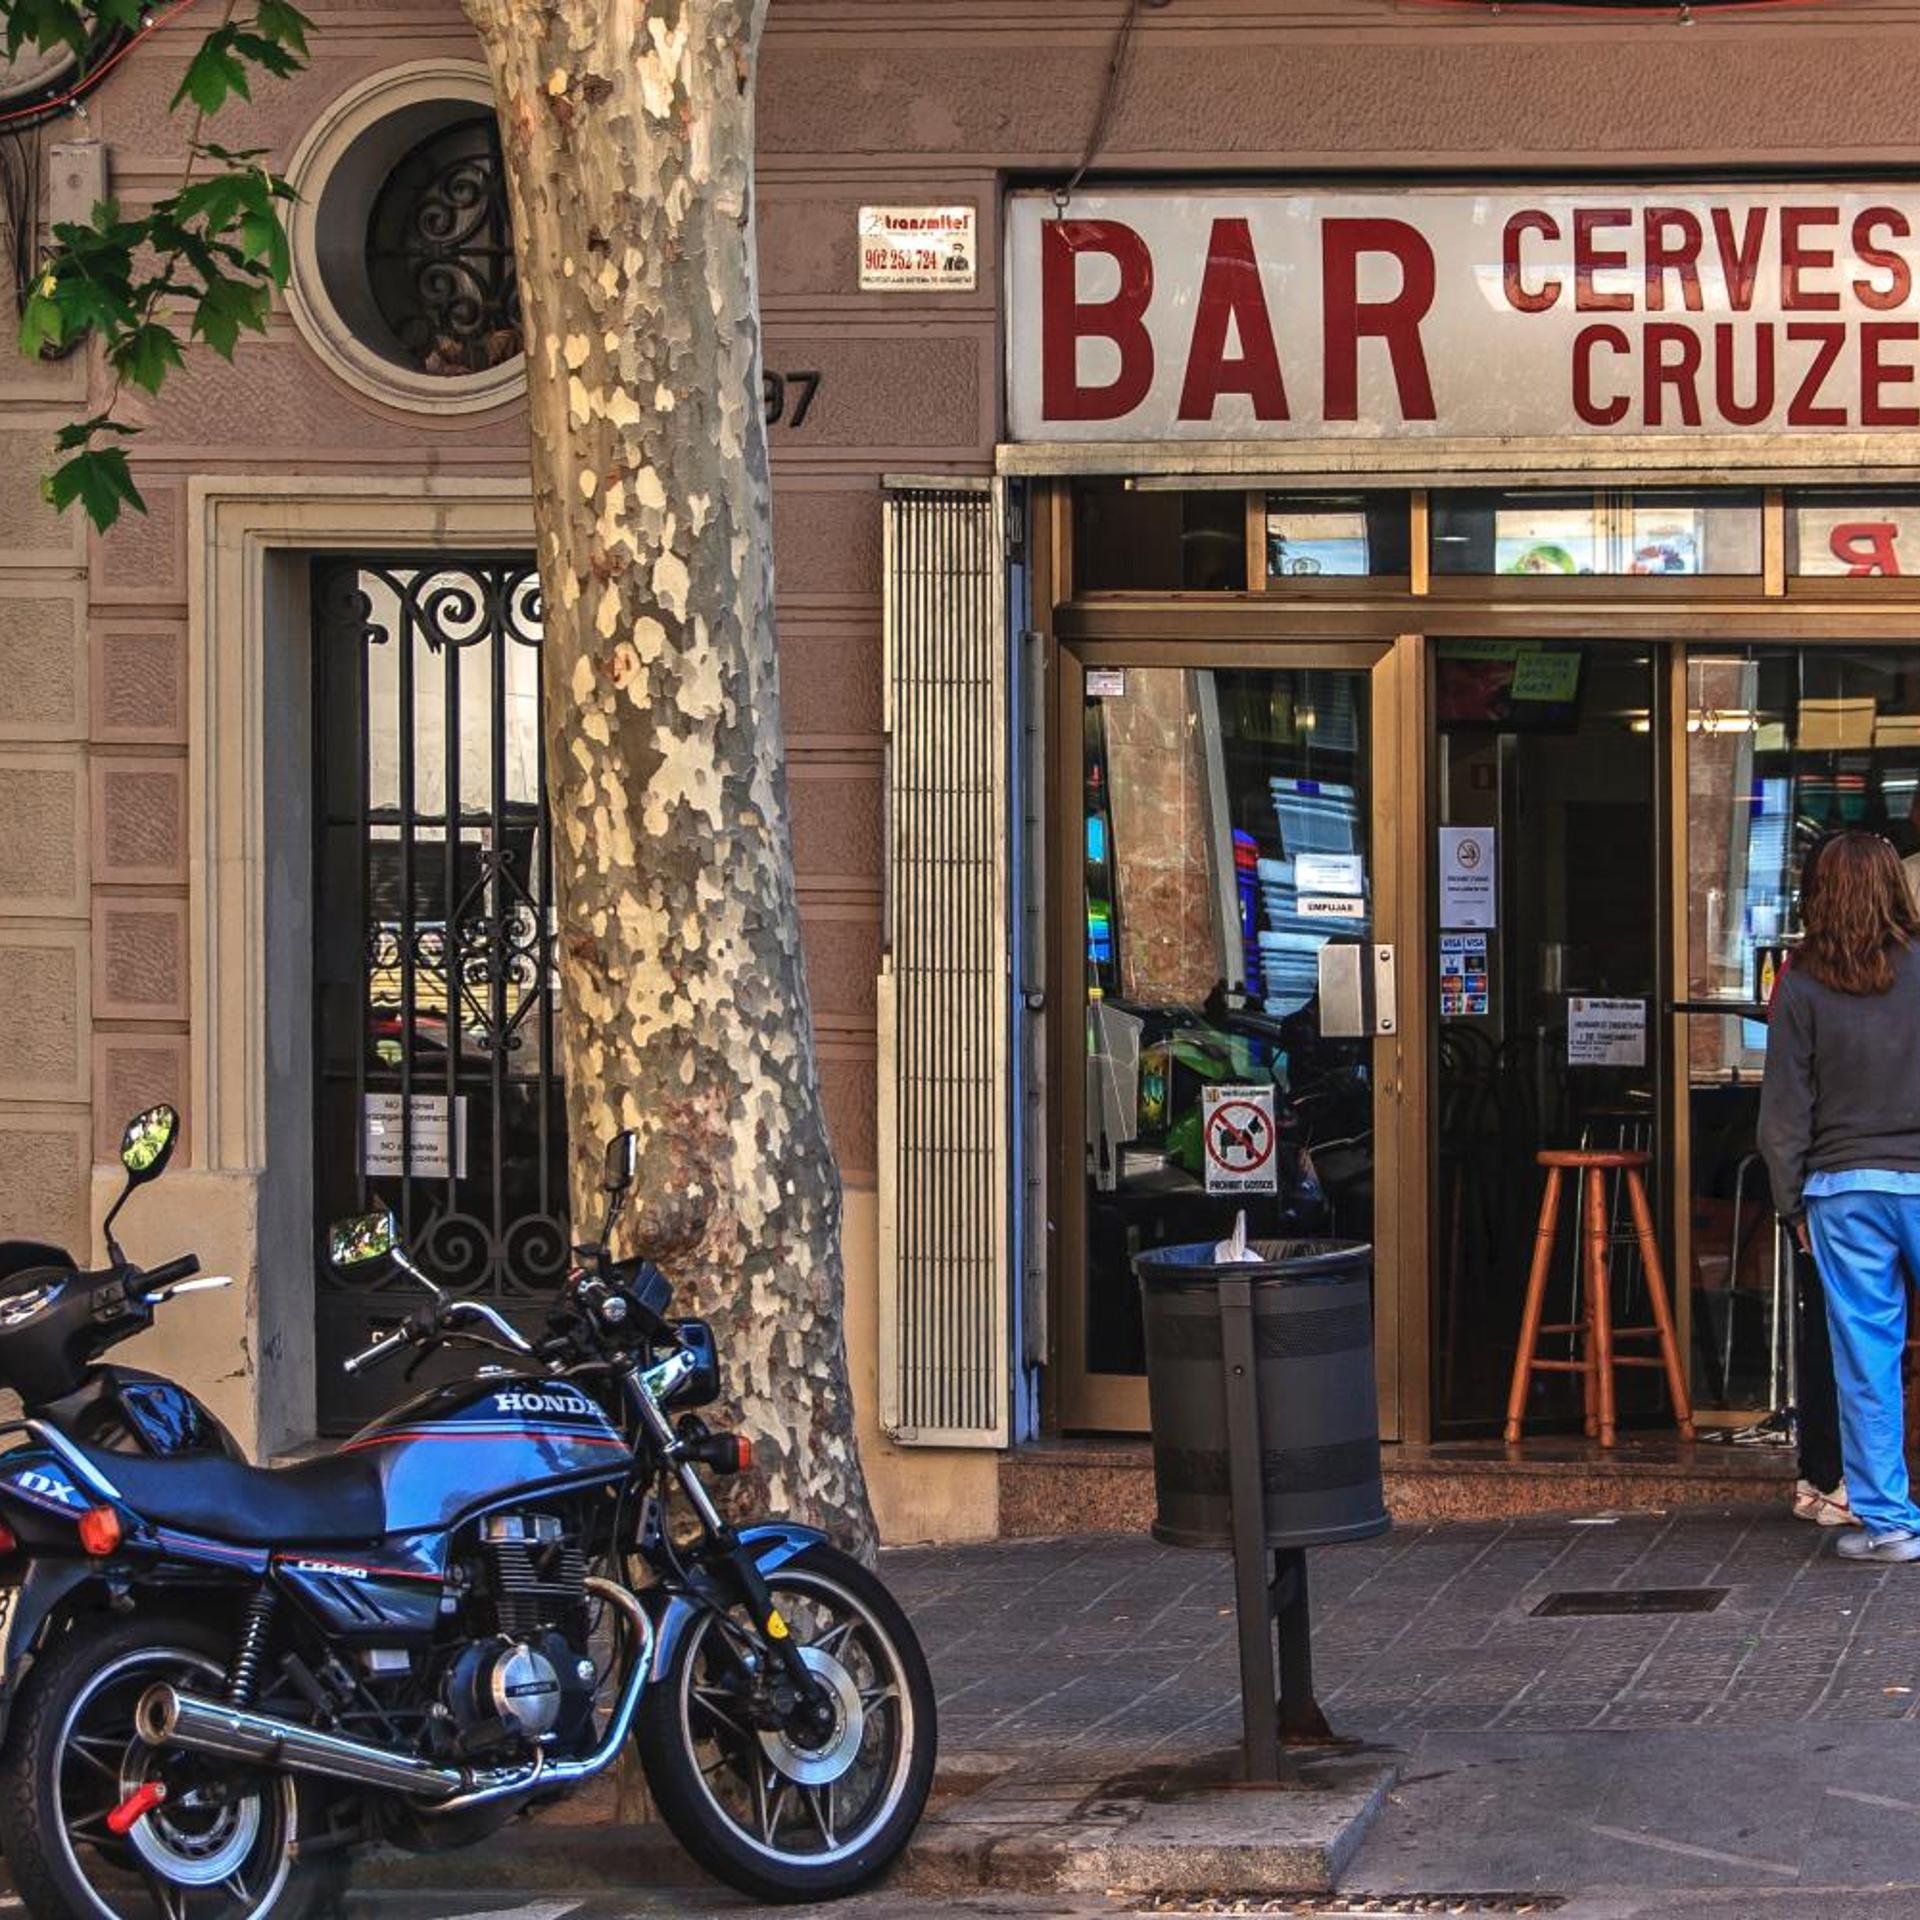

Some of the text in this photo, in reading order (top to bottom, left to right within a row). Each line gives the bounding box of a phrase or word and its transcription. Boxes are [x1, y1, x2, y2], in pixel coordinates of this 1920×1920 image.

[865, 249, 887, 270] 902
[915, 249, 937, 270] 724
[1502, 206, 1913, 313] CERVES
[1041, 217, 1438, 421] BAR
[1572, 322, 1920, 427] CRUZE
[1307, 903, 1354, 911] EMPUJAR
[1444, 938, 1485, 947] VISA VISA
[1209, 1181, 1274, 1190] PROHIBIT GOSSOS
[19, 1470, 75, 1503] DX
